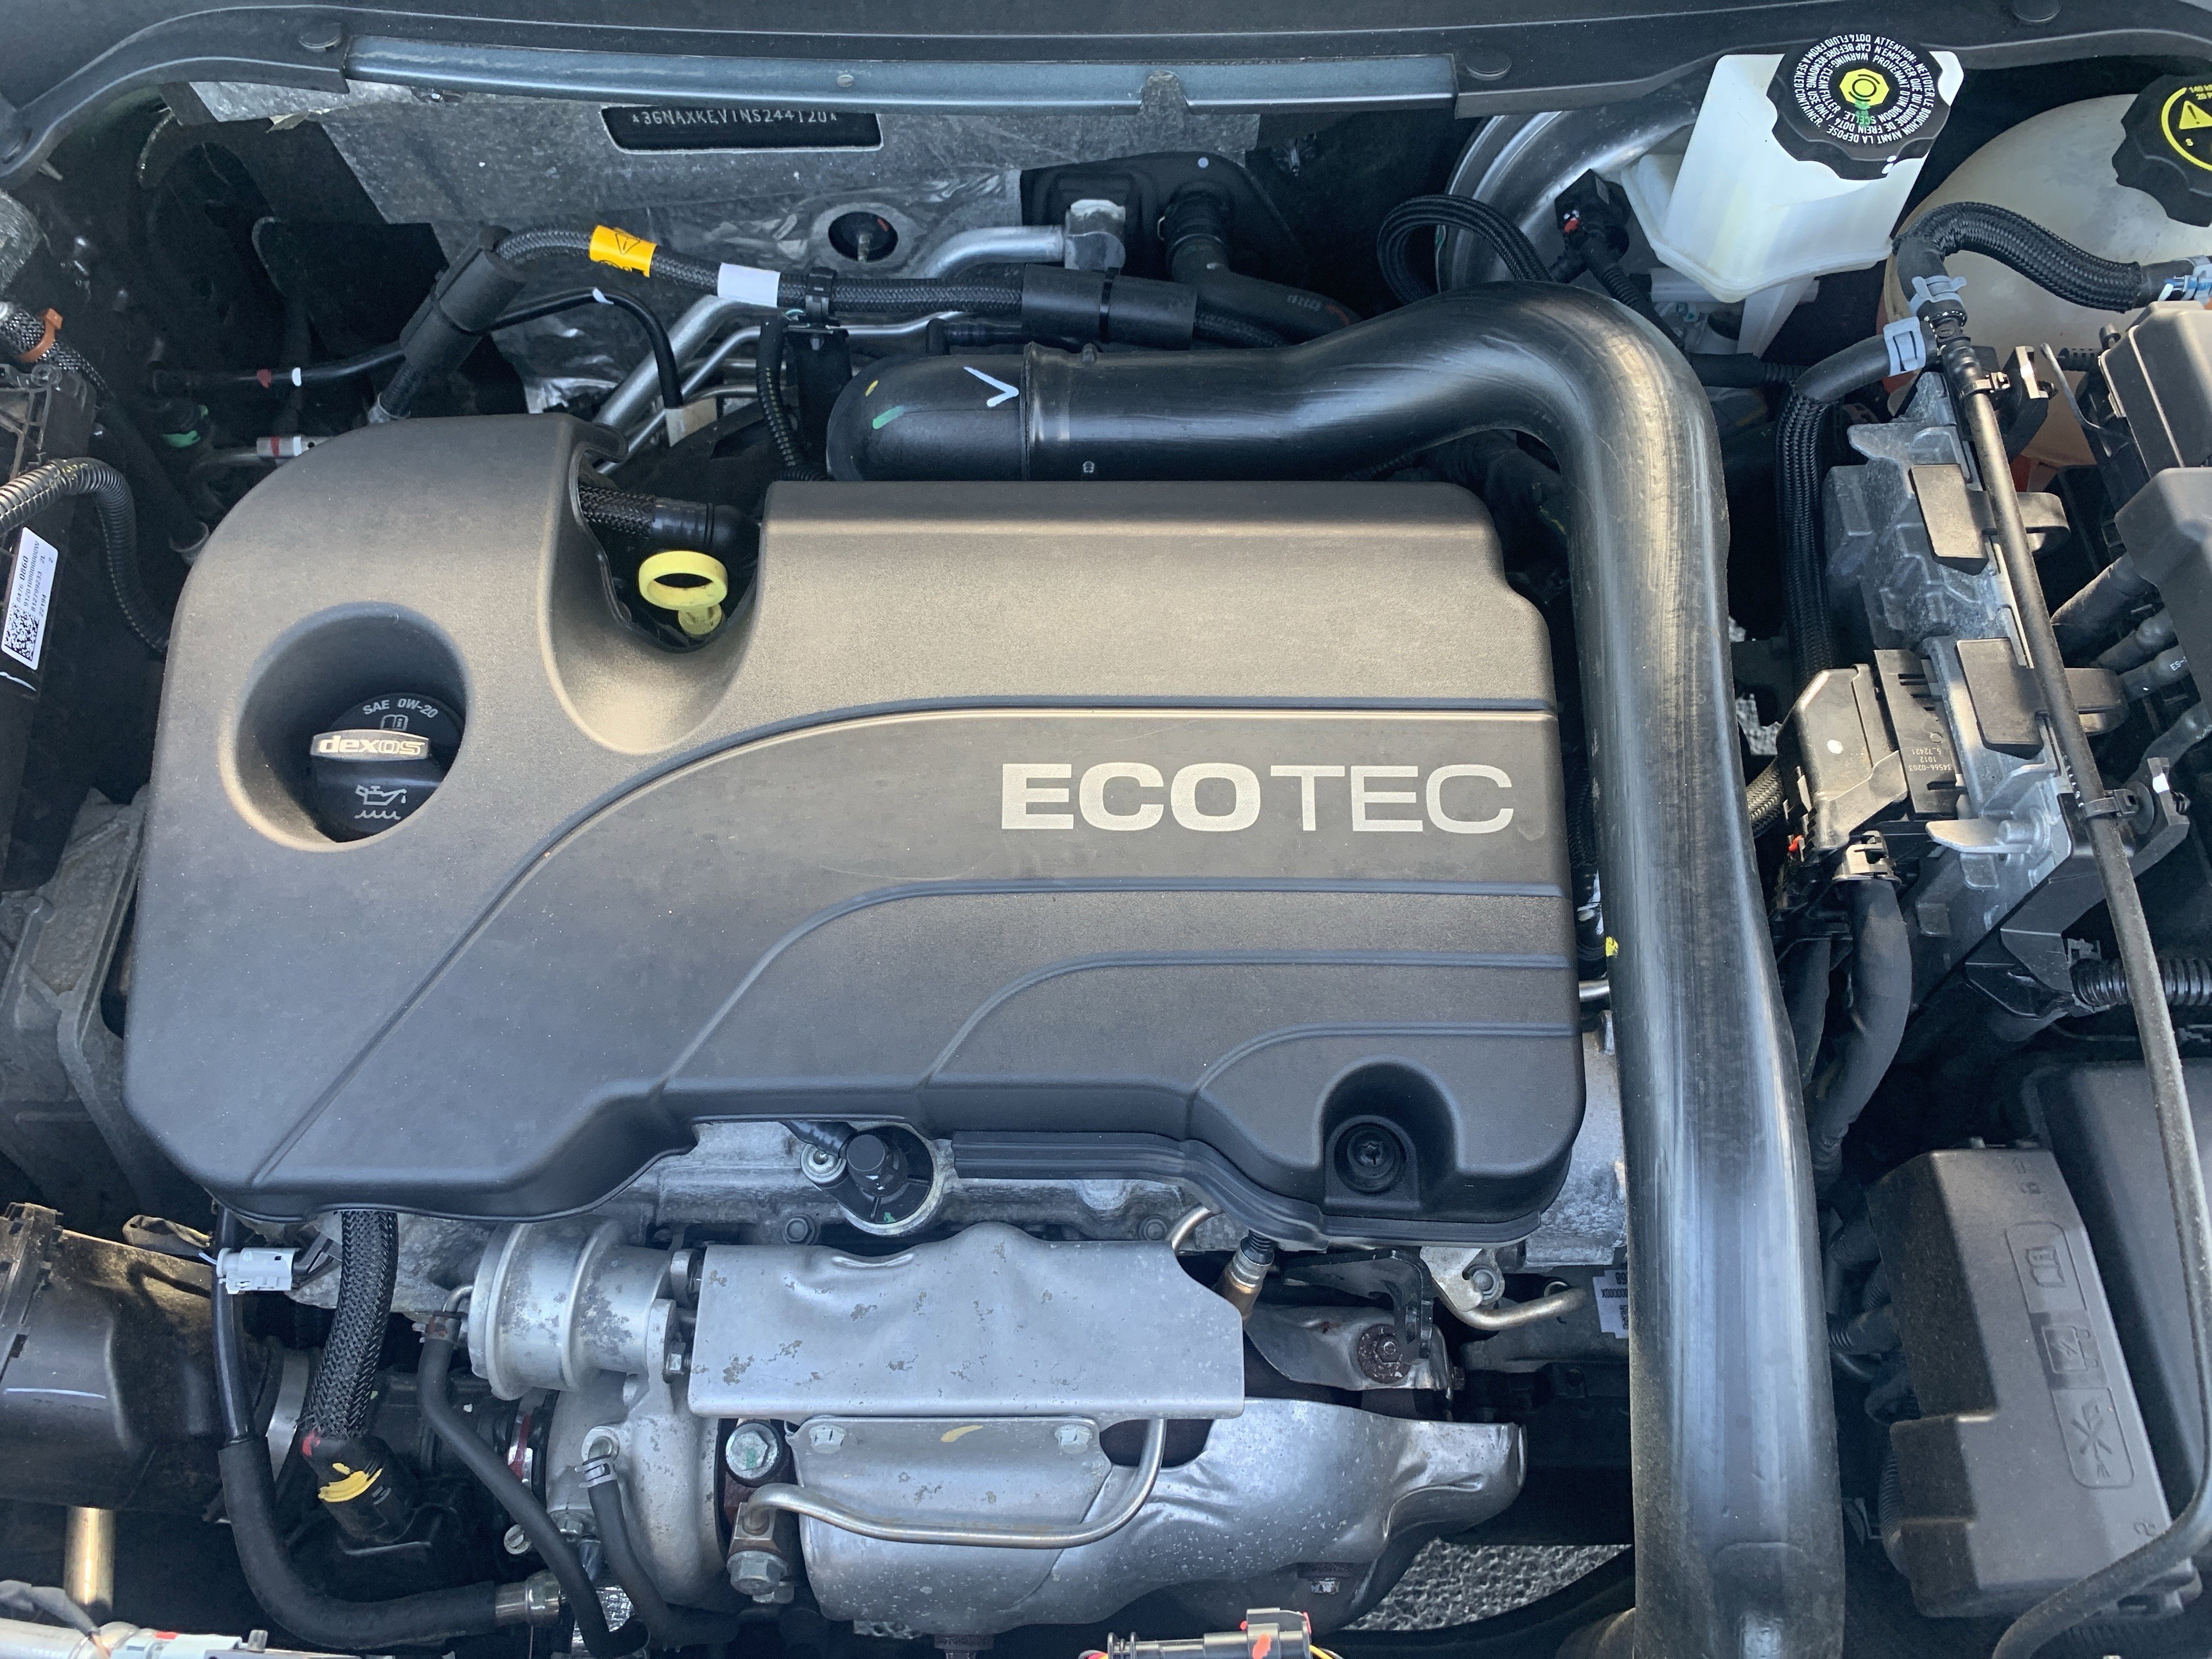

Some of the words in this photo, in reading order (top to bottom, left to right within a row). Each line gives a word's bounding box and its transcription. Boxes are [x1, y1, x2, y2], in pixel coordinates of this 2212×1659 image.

[1825, 35, 1849, 47] FLUID
[1849, 34, 1871, 42] DOT4
[1805, 43, 1827, 60] FROM
[1823, 43, 1854, 60] BEFORE
[1855, 43, 1871, 52] CAP
[1874, 36, 1917, 63] ATTENTION:
[1794, 63, 1808, 88] SEALED
[1806, 55, 1828, 90] REMOVING.
[1818, 67, 1833, 89] CLEAN
[1872, 54, 1910, 88] PROVENANT
[1910, 78, 1923, 92] QUE
[1915, 63, 1935, 97] NETTOYER
[1808, 91, 1821, 104] USE
[1819, 89, 1841, 114] FILLER
[1897, 91, 1910, 108] D'UN
[1911, 93, 1922, 104] DU
[1923, 98, 1934, 108] LE
[1795, 89, 1823, 127] CONTAINER.
[1815, 104, 1835, 120] ONLY
[1877, 106, 1903, 123] BIDON
[1894, 103, 1920, 127] LIQUIDE
[1833, 117, 1855, 132] DOT4
[1858, 125, 1883, 134] FREIN
[1883, 122, 1897, 132] DE
[1901, 108, 1931, 135] BOUCHON
[1862, 136, 1874, 144] LA
[1877, 131, 1903, 144] AVANT
[19, 555, 29, 580] 0860
[363, 699, 390, 715] SAE
[398, 698, 438, 719] 0W-20
[320, 735, 425, 755] dexos
[1001, 763, 1514, 833] ECOTEC
